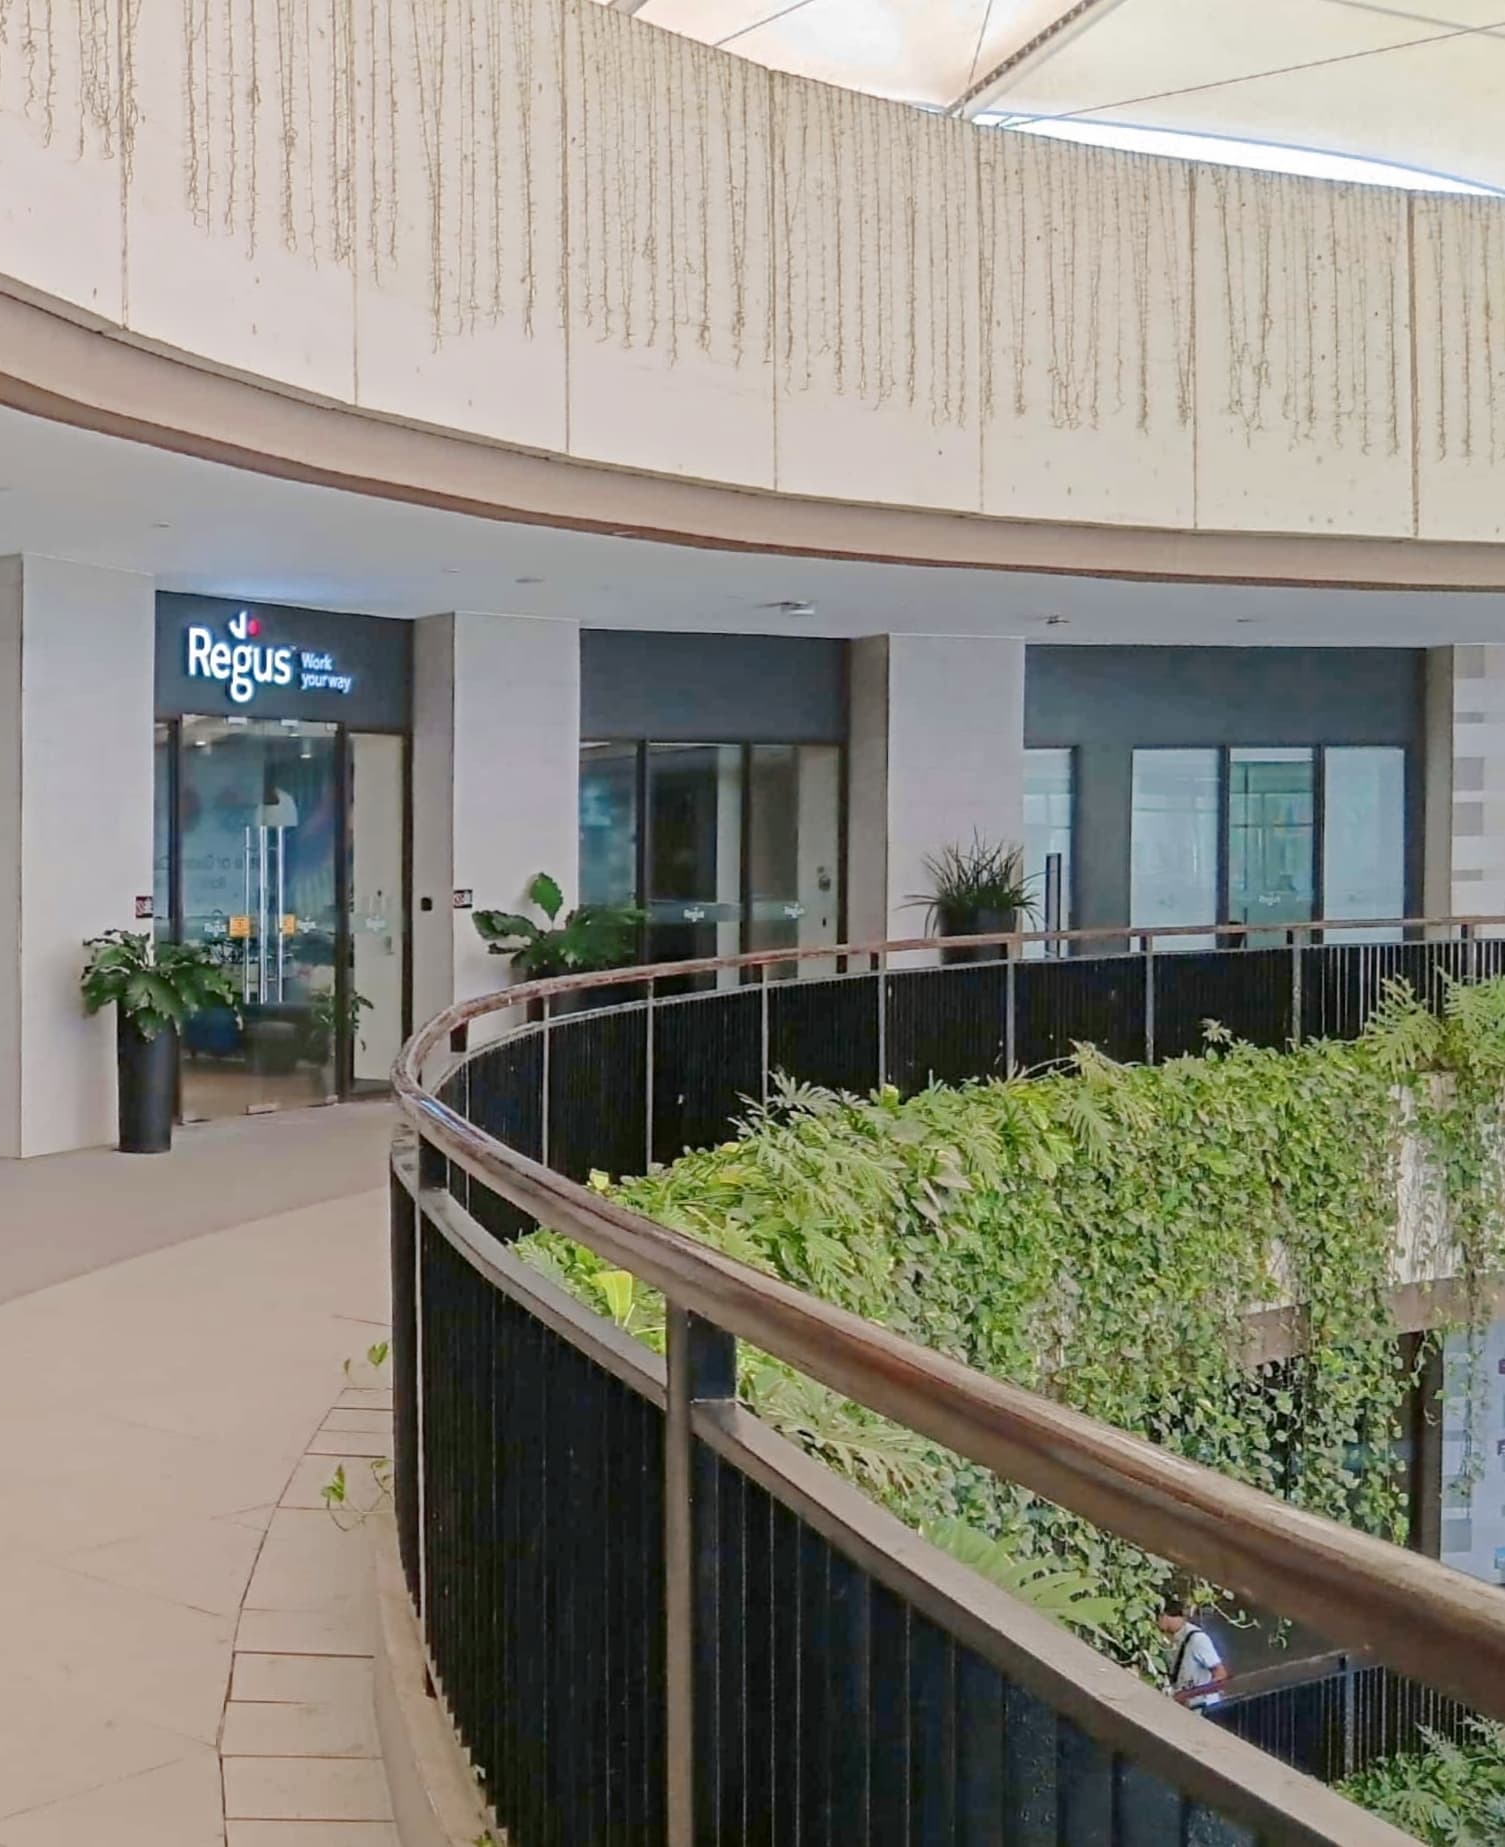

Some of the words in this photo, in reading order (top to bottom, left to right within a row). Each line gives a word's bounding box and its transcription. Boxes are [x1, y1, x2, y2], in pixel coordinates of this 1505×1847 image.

[188, 626, 293, 703] Regus
[302, 652, 332, 671] Work
[301, 672, 327, 690] your
[328, 677, 352, 694] way
